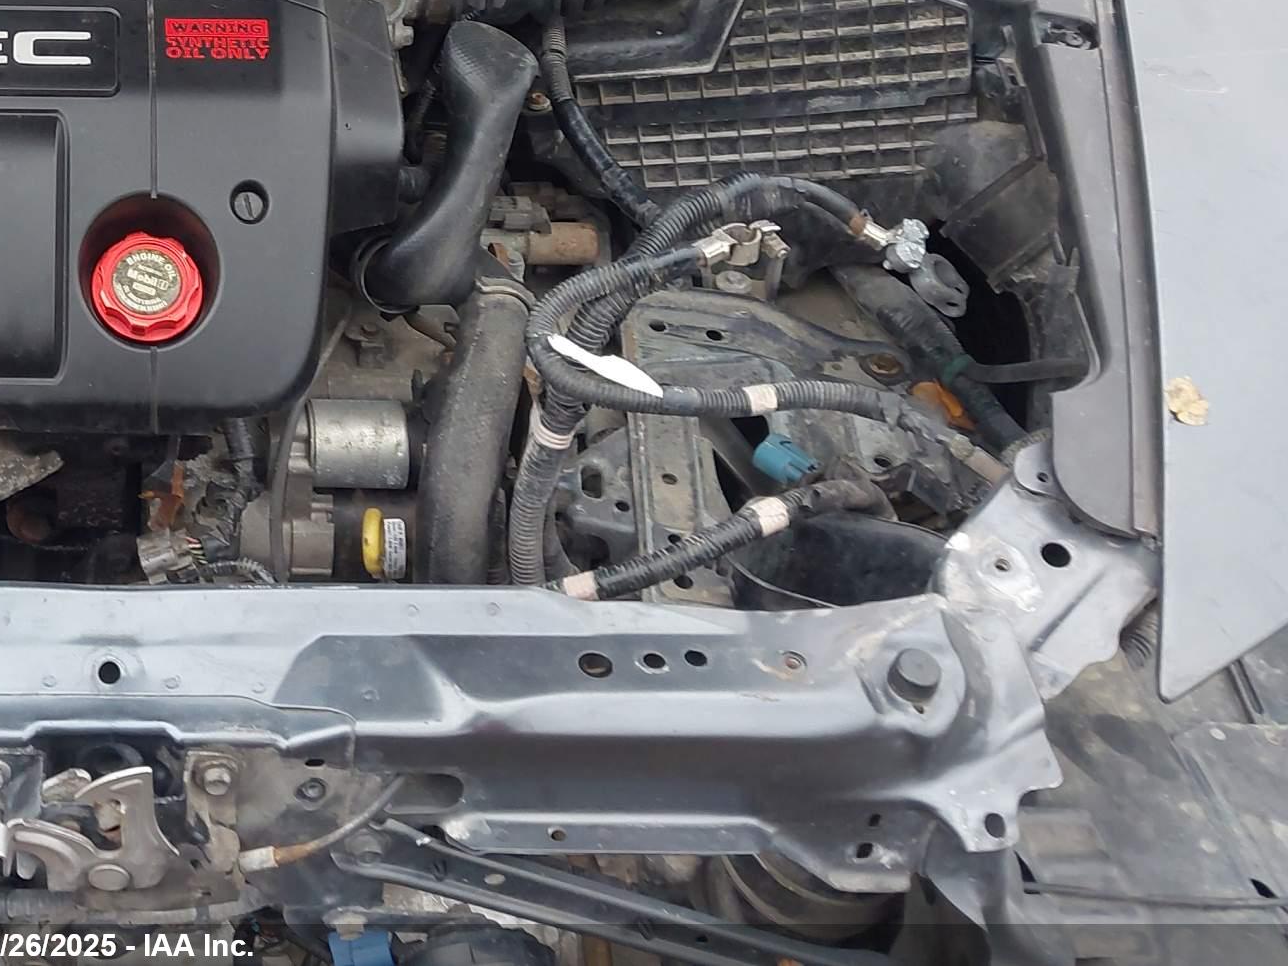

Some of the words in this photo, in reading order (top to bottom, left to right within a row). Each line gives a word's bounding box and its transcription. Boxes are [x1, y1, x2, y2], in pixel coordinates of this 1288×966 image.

[171, 22, 262, 34] WARNING
[165, 37, 270, 47] SYNTHETIC
[166, 46, 205, 59] OIL
[211, 47, 269, 59] ONLY
[126, 252, 165, 265] ENGINE
[164, 263, 177, 281] OIL
